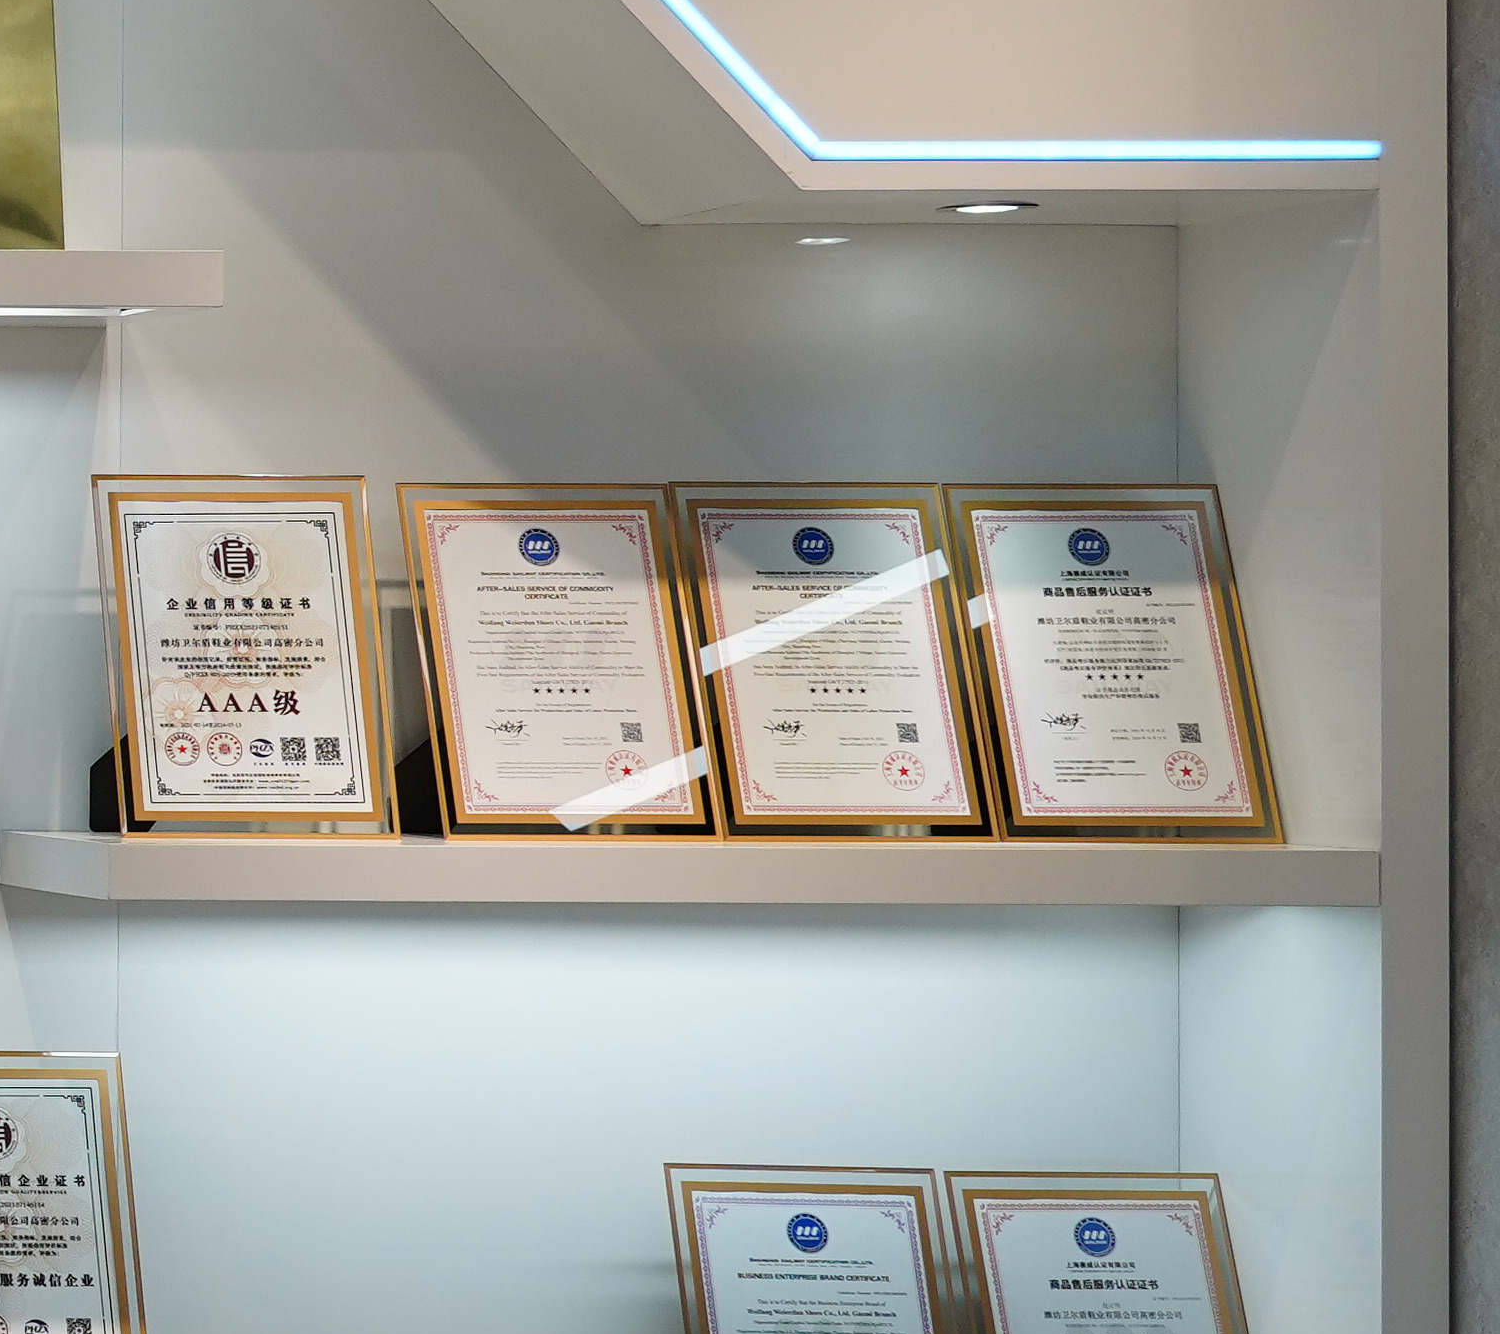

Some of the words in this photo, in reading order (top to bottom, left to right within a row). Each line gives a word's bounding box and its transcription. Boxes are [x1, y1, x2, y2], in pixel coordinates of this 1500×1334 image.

[166, 597, 311, 610] 企业信用等级证书
[197, 689, 301, 716] AAA级
